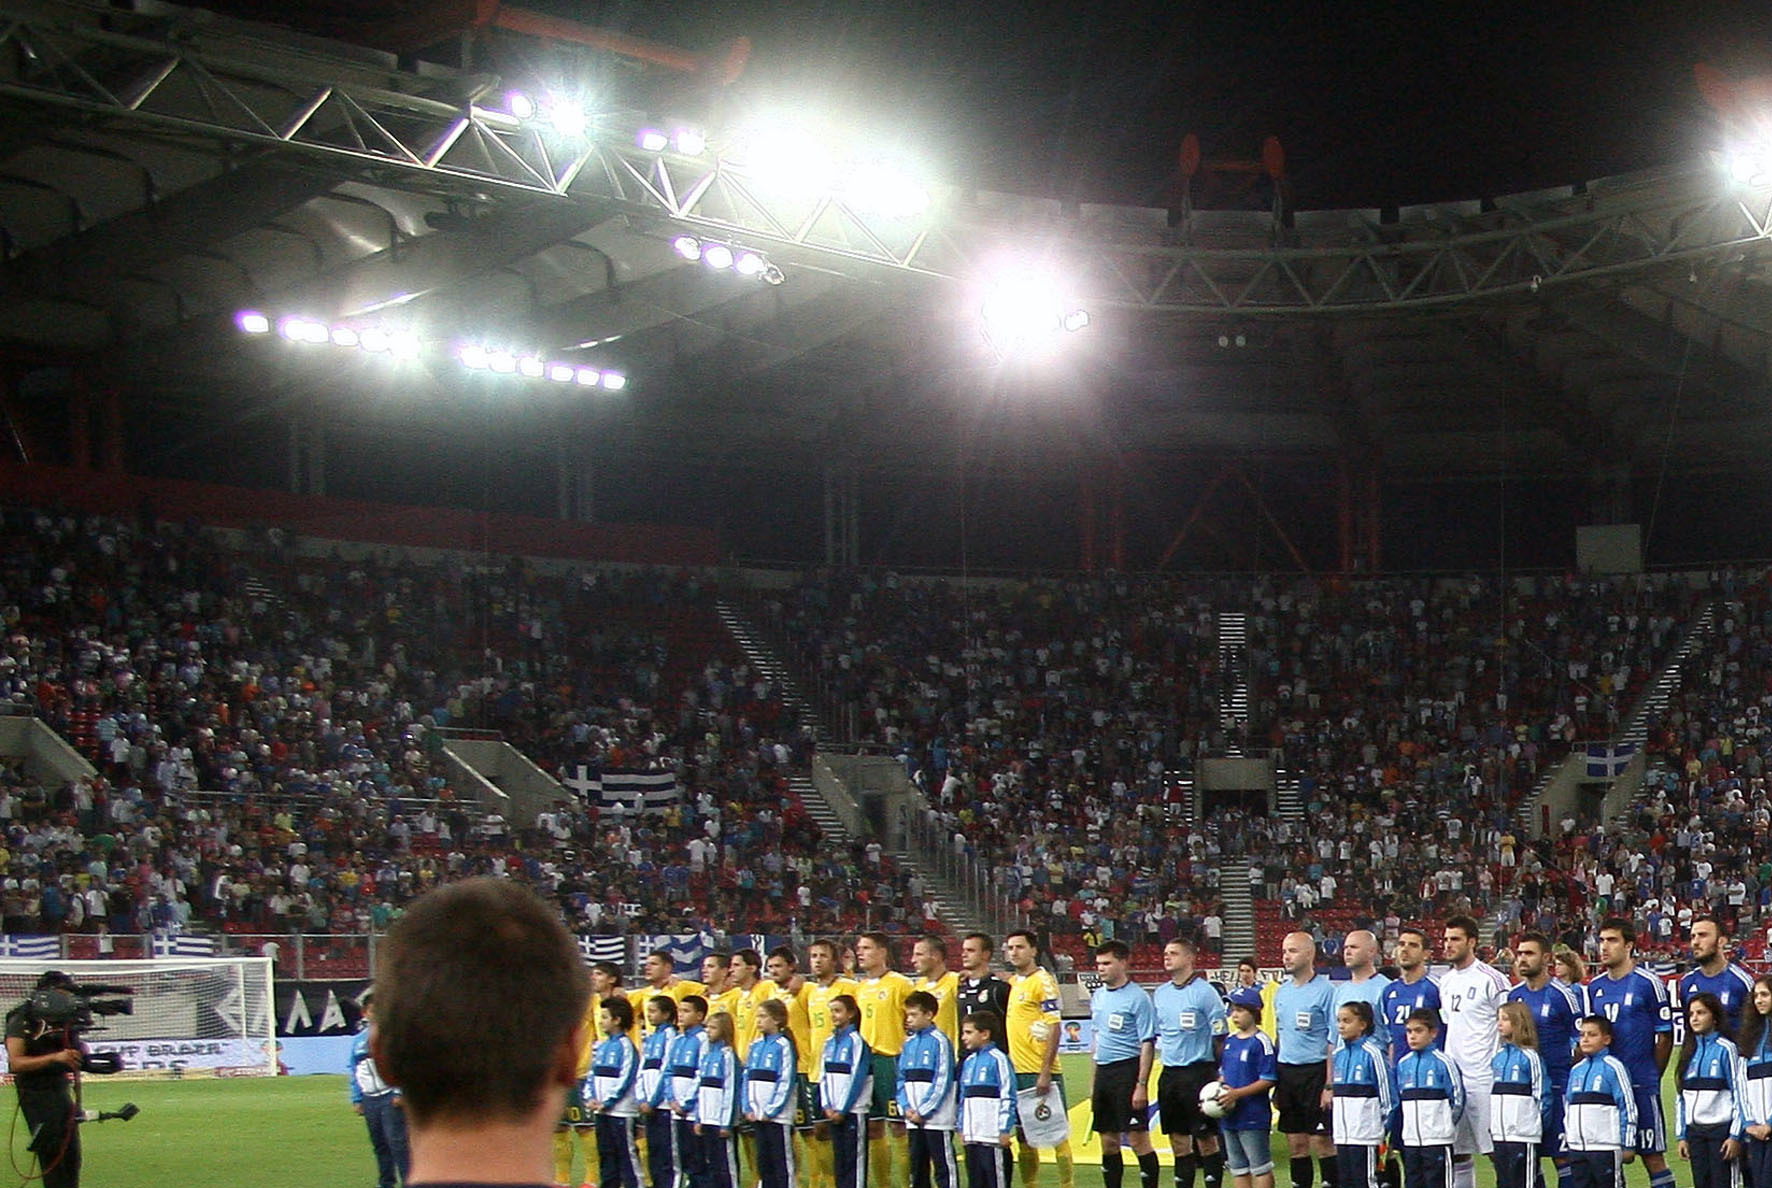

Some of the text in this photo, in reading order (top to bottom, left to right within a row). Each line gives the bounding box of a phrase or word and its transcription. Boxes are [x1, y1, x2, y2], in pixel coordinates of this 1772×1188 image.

[1451, 993, 1462, 1012] 12
[1394, 1004, 1411, 1024] 21
[1638, 1128, 1655, 1149] 19
